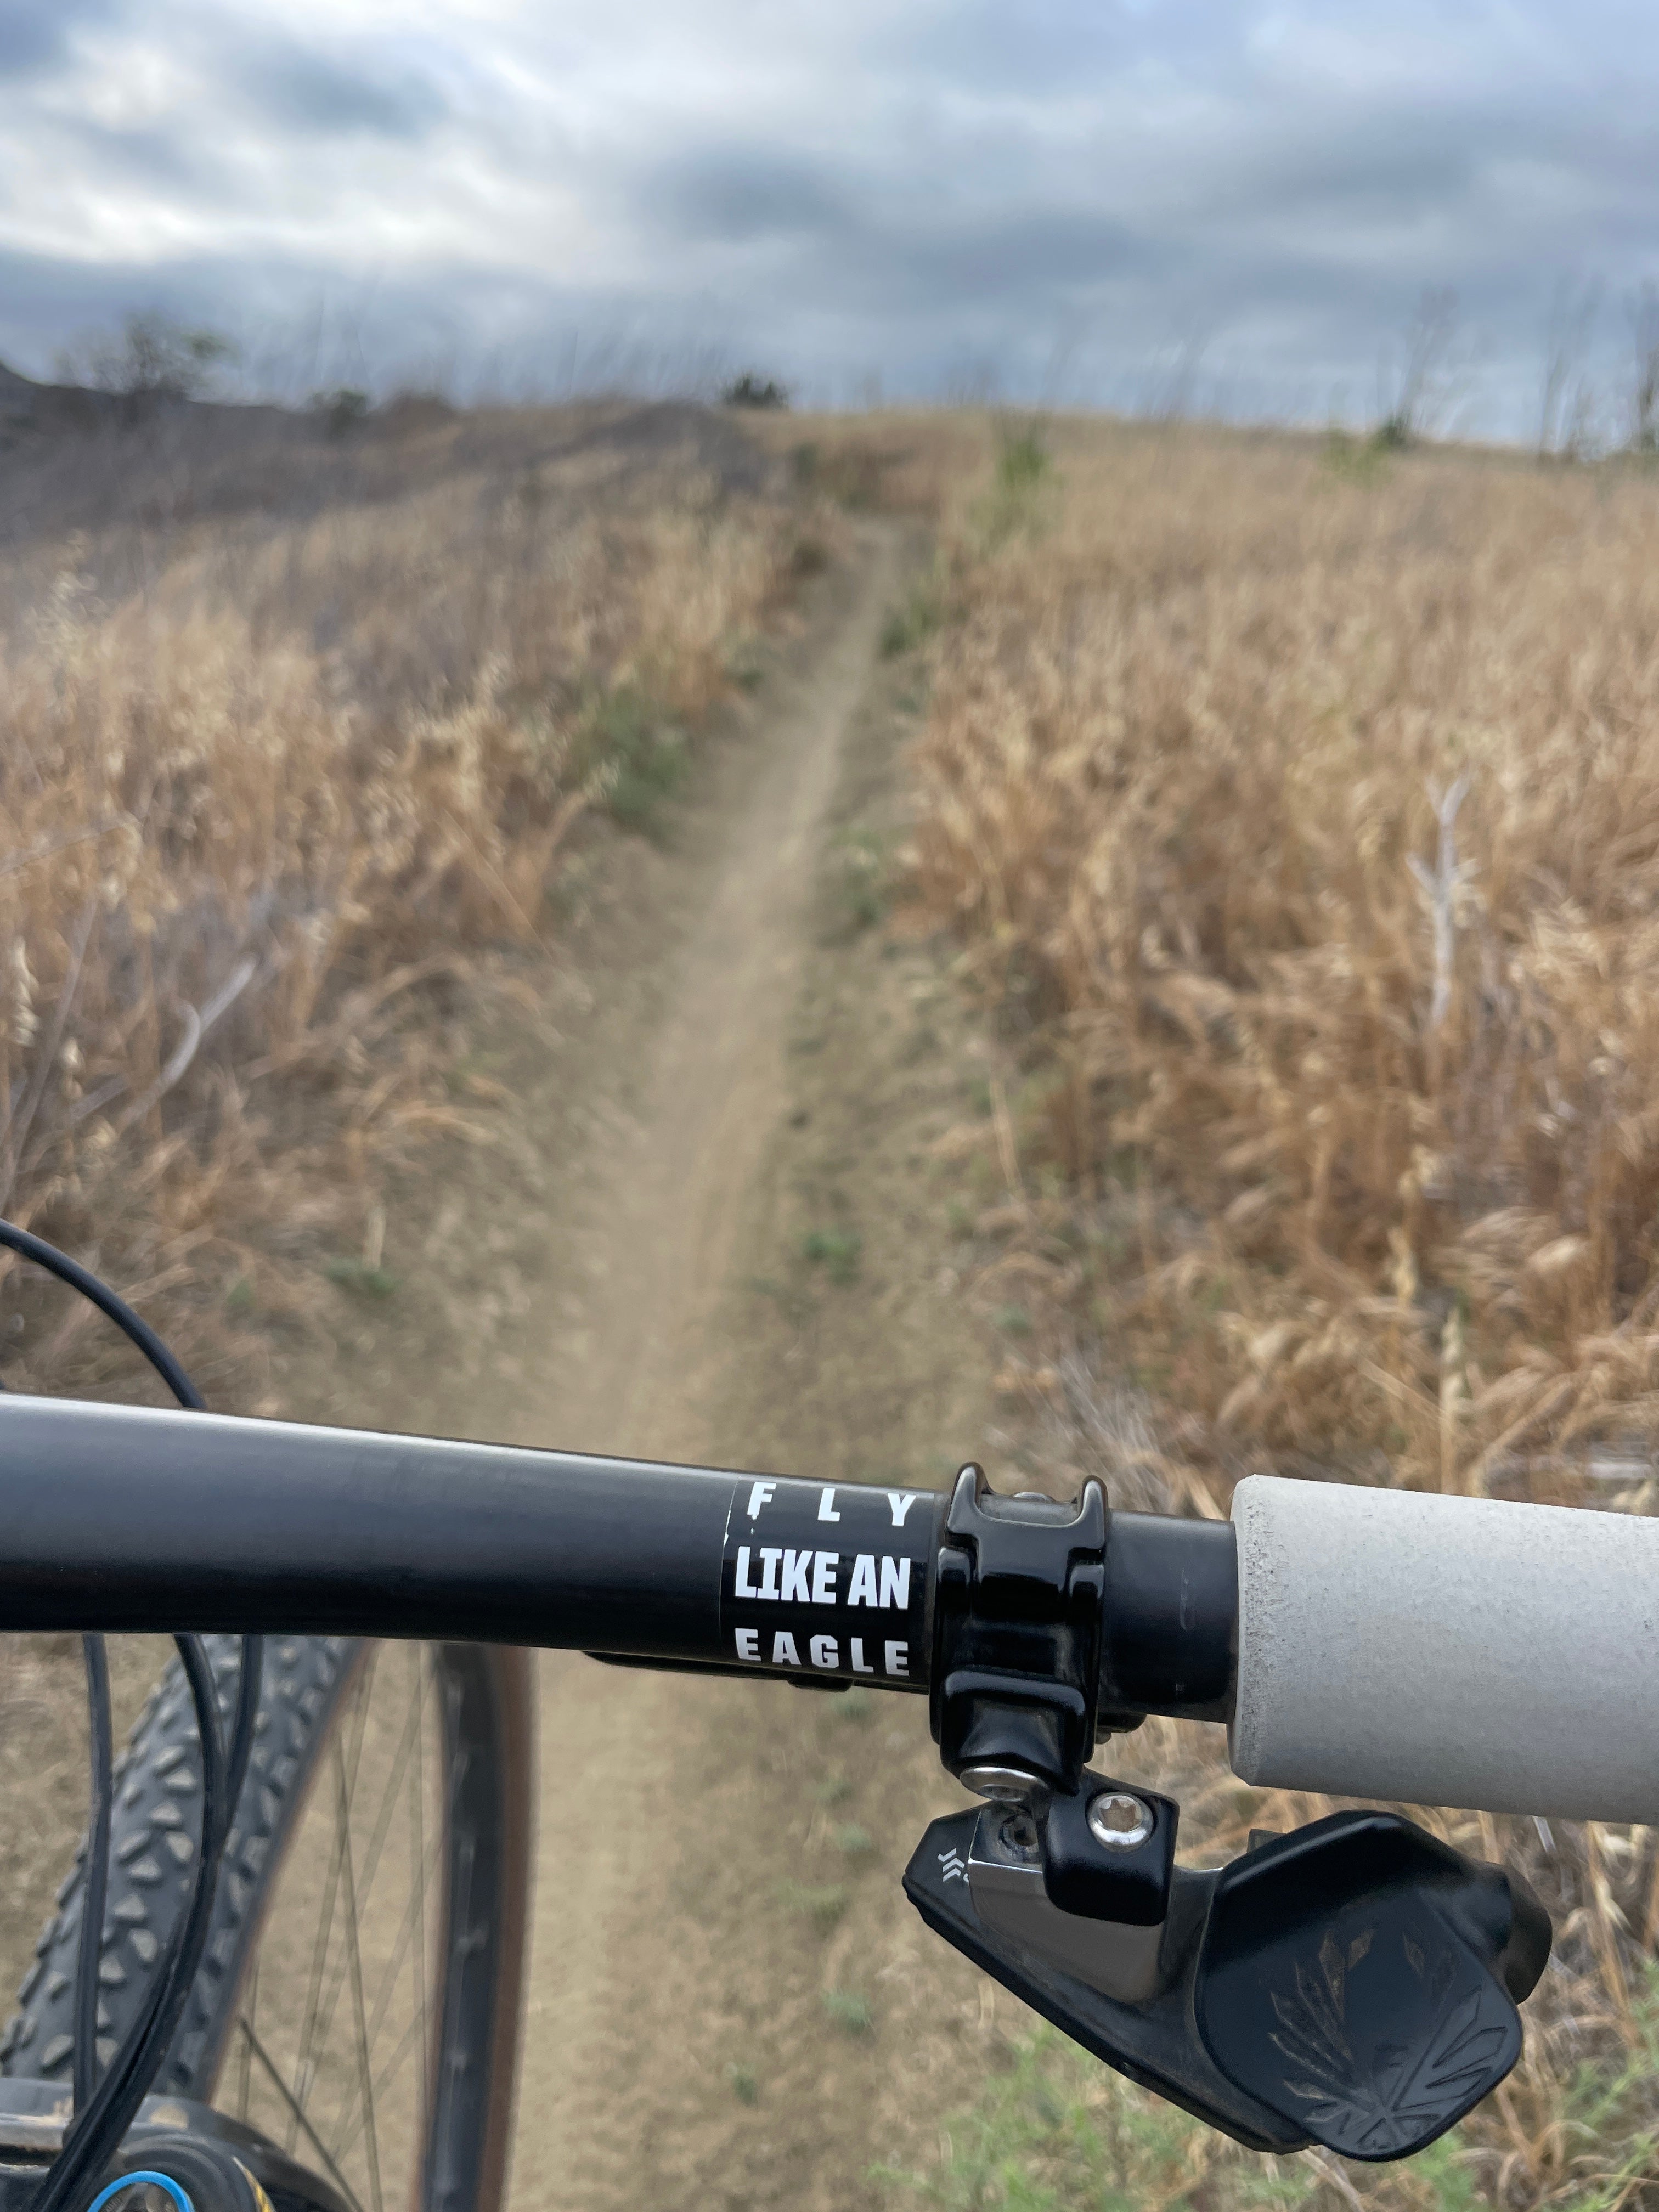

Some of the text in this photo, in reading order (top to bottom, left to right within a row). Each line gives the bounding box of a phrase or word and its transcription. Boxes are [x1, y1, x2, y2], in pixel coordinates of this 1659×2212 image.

[747, 1482, 917, 1526] FLY
[735, 1546, 911, 1609] LIKE AN
[735, 1628, 910, 1676] EAGLE
